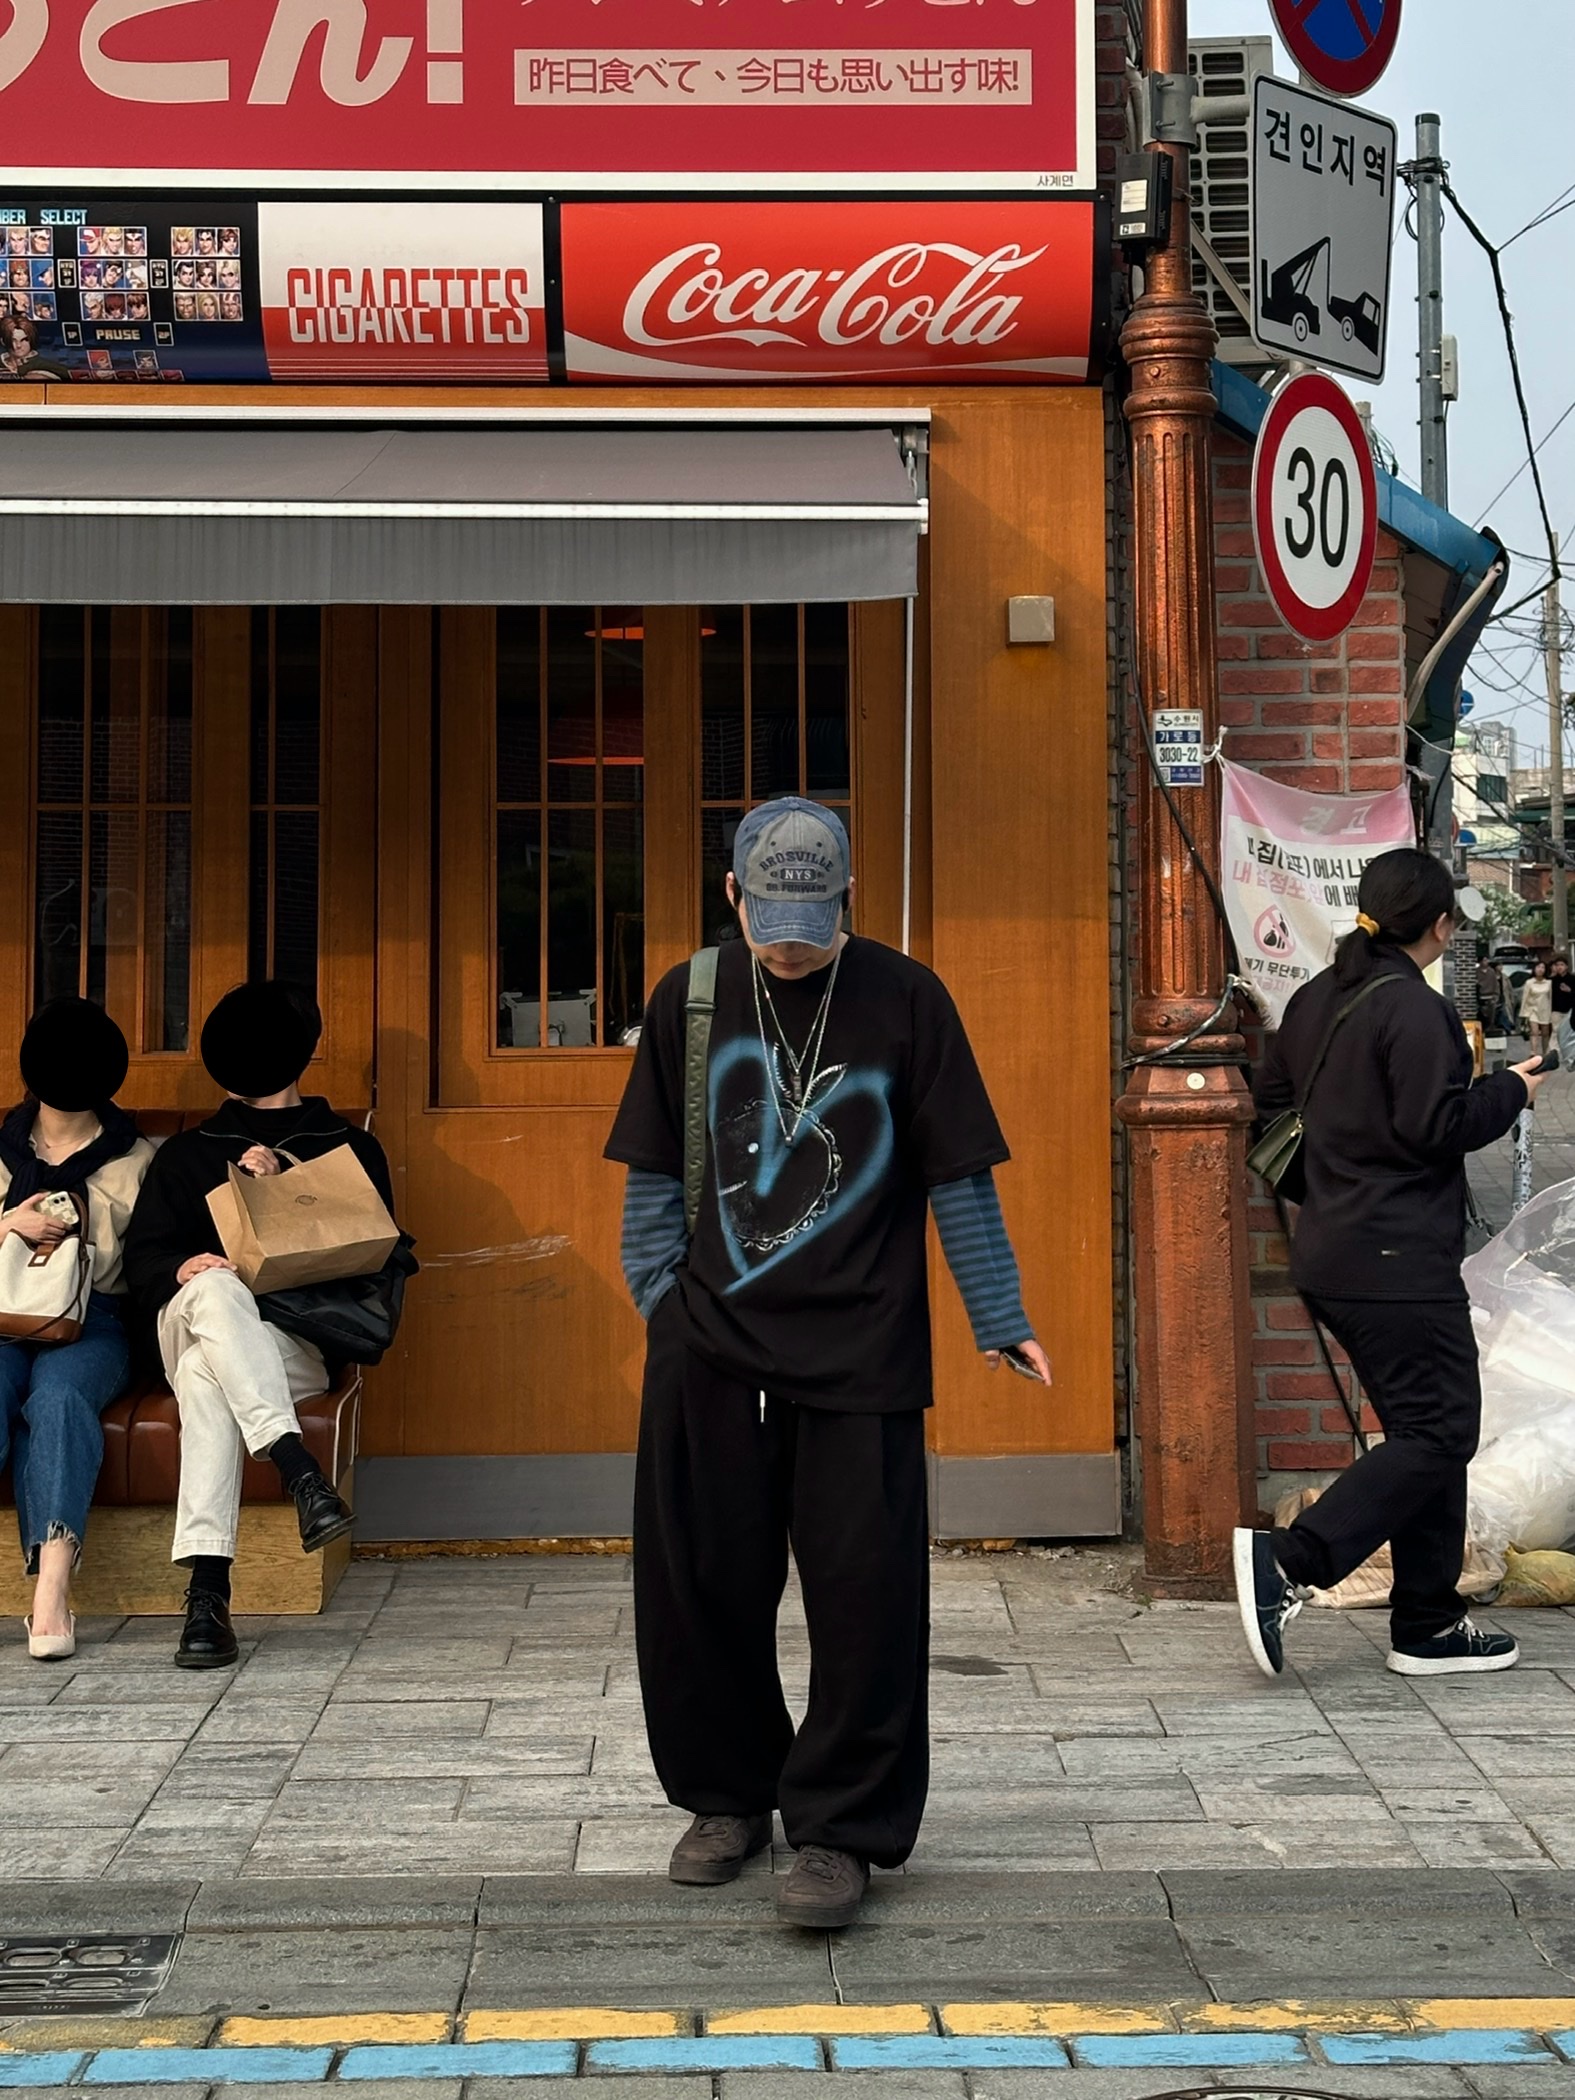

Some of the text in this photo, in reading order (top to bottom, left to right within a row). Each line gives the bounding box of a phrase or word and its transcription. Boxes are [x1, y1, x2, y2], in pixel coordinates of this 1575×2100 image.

[1264, 108, 1386, 197] 견인지역
[0, 208, 88, 225] BER SELECT
[622, 242, 1050, 347] Coca-Cola
[287, 267, 531, 344] CIGARETTES
[96, 329, 141, 340] PAUSE
[1284, 446, 1350, 568] 30
[1159, 731, 1197, 743] 가로등
[1160, 747, 1198, 763] 3030-22
[759, 851, 834, 873] BROSVILLE
[785, 869, 812, 880] NYS
